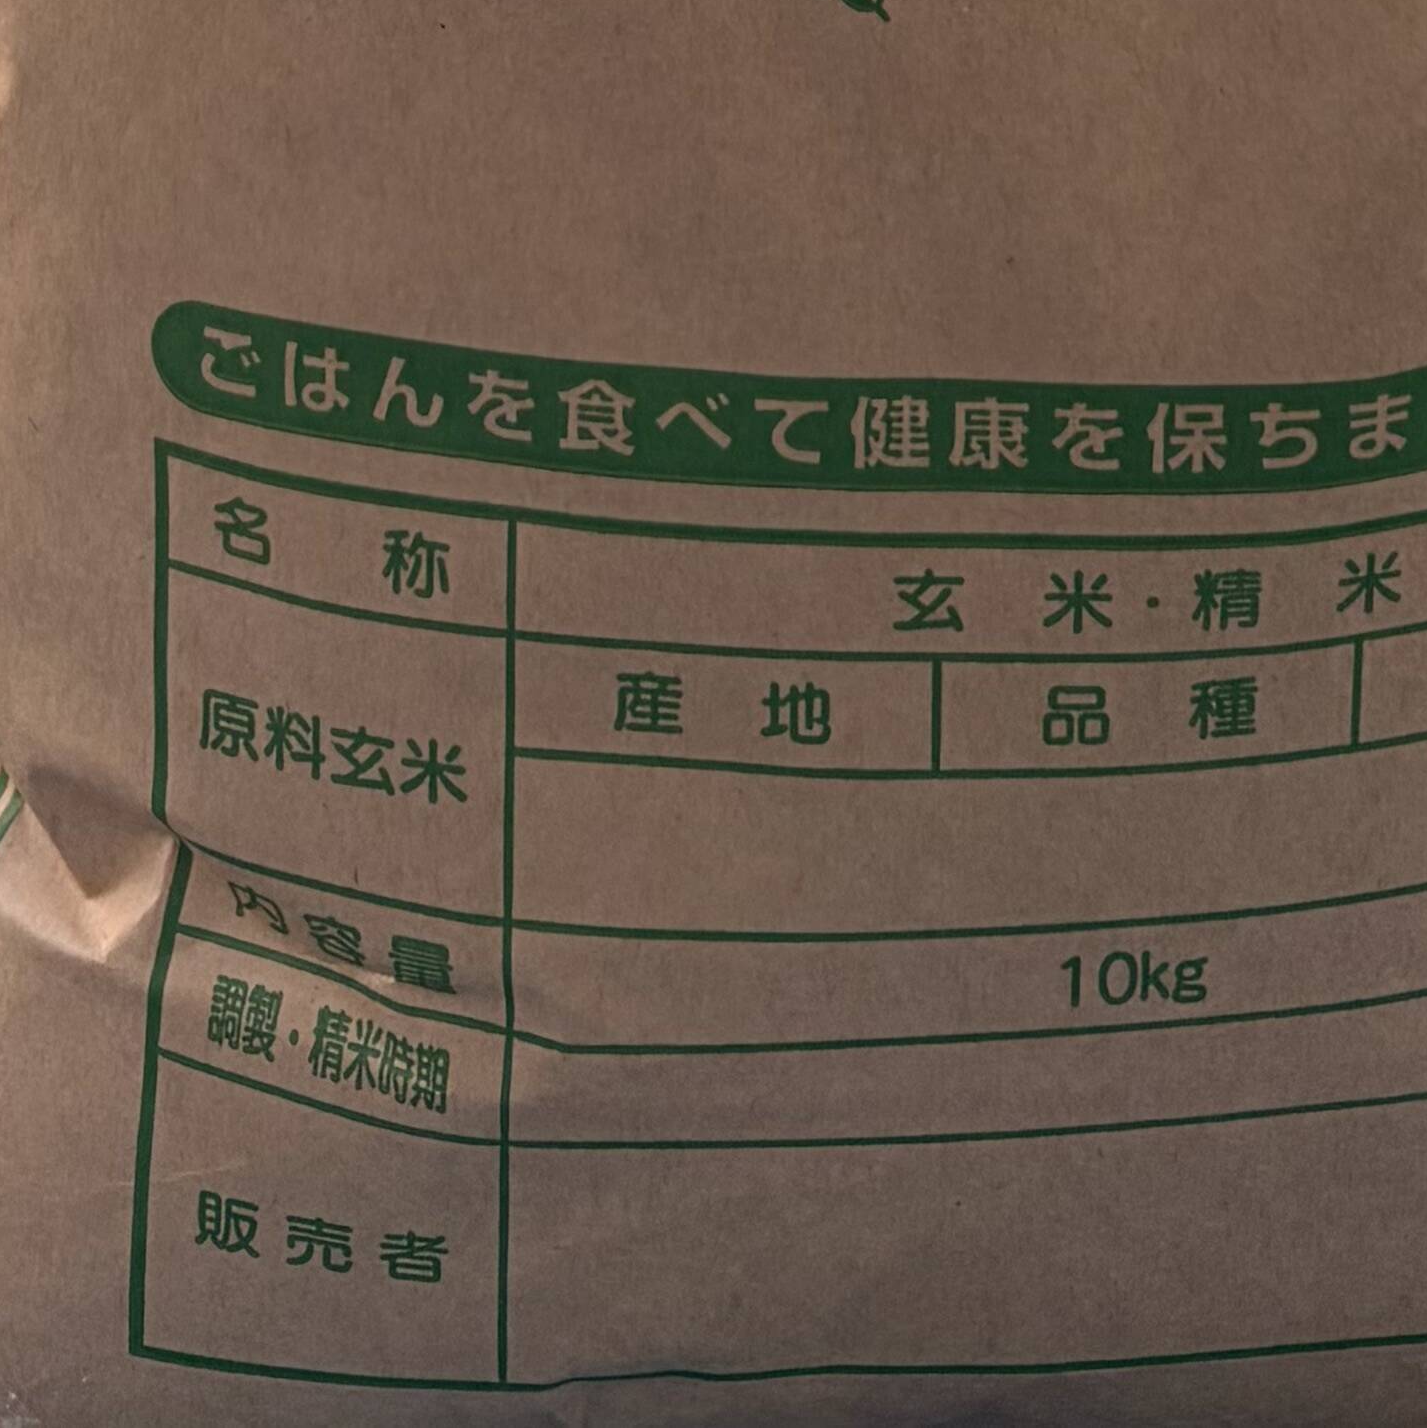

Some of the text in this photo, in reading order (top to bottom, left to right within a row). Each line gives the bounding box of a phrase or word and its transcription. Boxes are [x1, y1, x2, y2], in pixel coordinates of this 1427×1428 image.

[199, 688, 467, 805] 原料玄米
[1060, 950, 1209, 1008] 10kg
